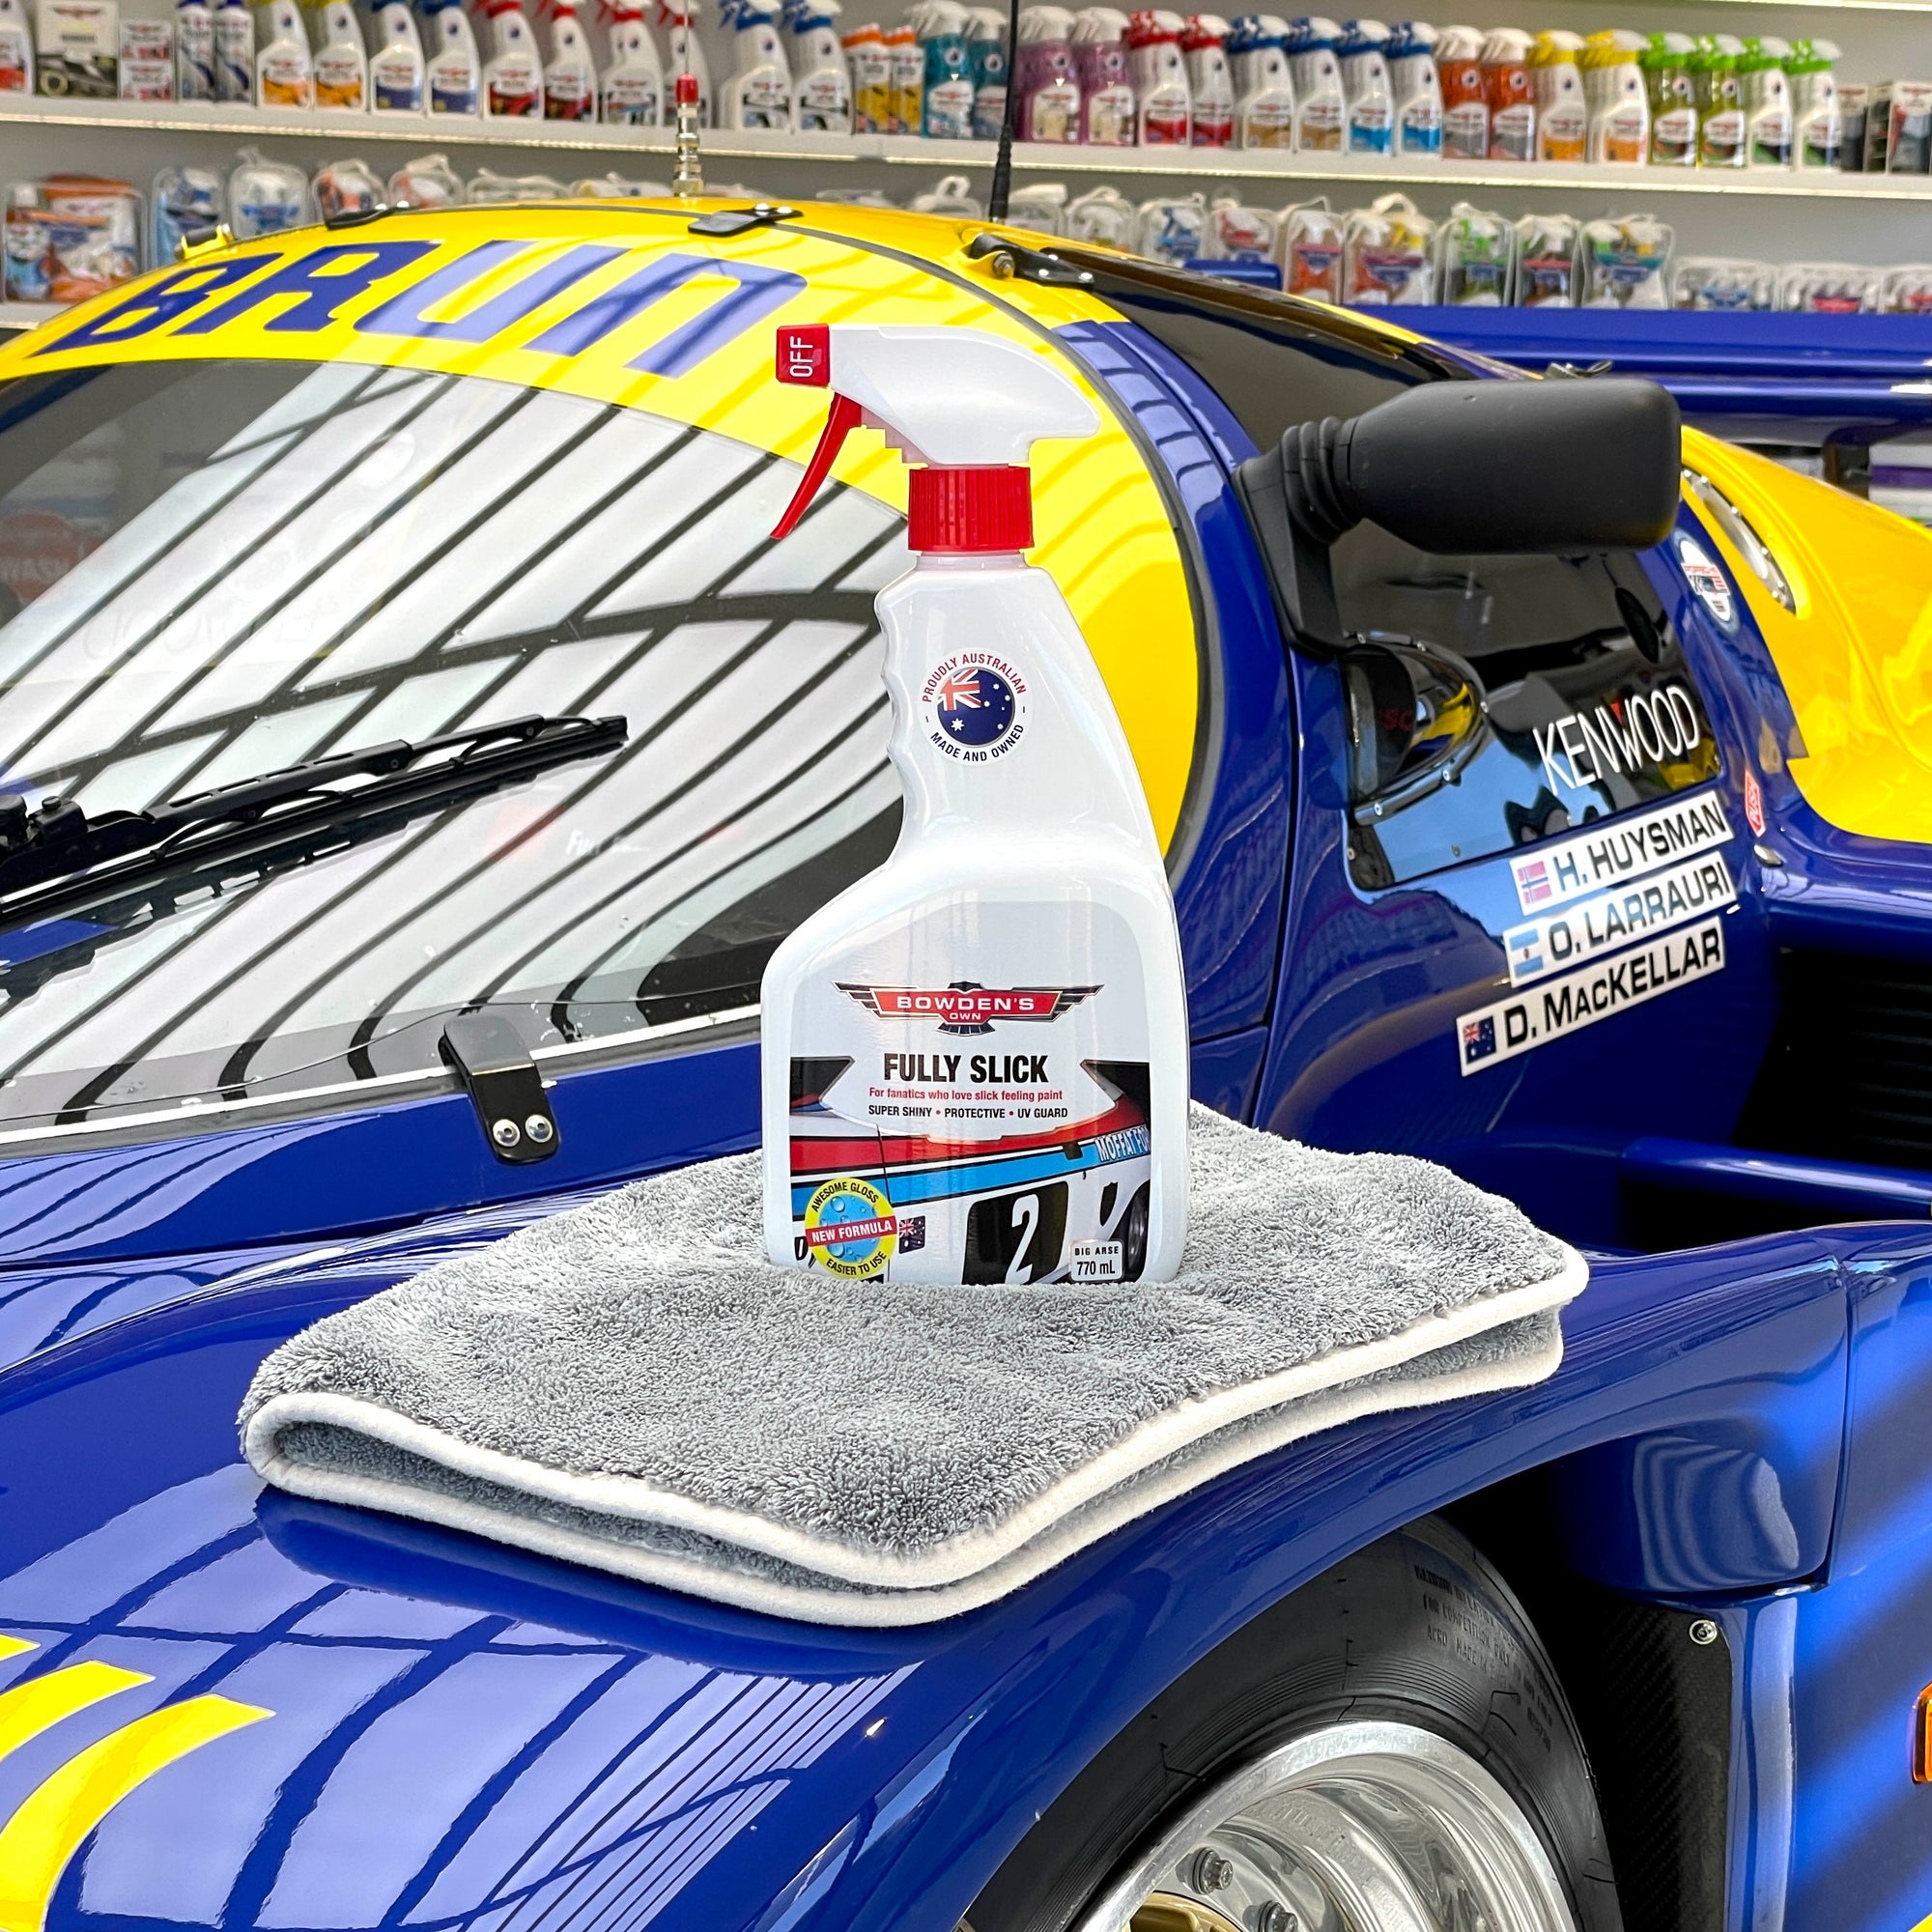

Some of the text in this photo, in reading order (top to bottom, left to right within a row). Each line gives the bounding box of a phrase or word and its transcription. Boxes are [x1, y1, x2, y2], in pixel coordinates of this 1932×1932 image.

[25, 239, 808, 379] BRUN
[789, 335, 813, 378] OFF
[922, 653, 1027, 702] PROUDLY AUSTRALIAN
[930, 724, 1024, 762] MADE AND OWNED
[1532, 685, 1700, 797] KENWOOD
[1552, 851, 1589, 893] H.
[1590, 799, 1728, 880] HUYSMAN
[1548, 859, 1731, 961] O. LARRAURI
[896, 996, 1035, 1011] BOWDEN'S
[1503, 1009, 1538, 1049] D.
[883, 1053, 1049, 1084] FULLY SLICK
[868, 1088, 1063, 1102] For fanatics who love slick feeling paint
[868, 1105, 1068, 1119] SUPER SHINY PROTECTIVE UV GUARD
[1094, 1129, 1137, 1161] MOFFAT
[811, 1181, 879, 1212] AWESOME GLOSS
[811, 1220, 893, 1243] NEW FORMULA
[1005, 1194, 1038, 1286] 2
[826, 1251, 887, 1275] EASIER TO USE
[1074, 1246, 1119, 1256] BIG ARSE
[1076, 1260, 1116, 1276] 770 mL
